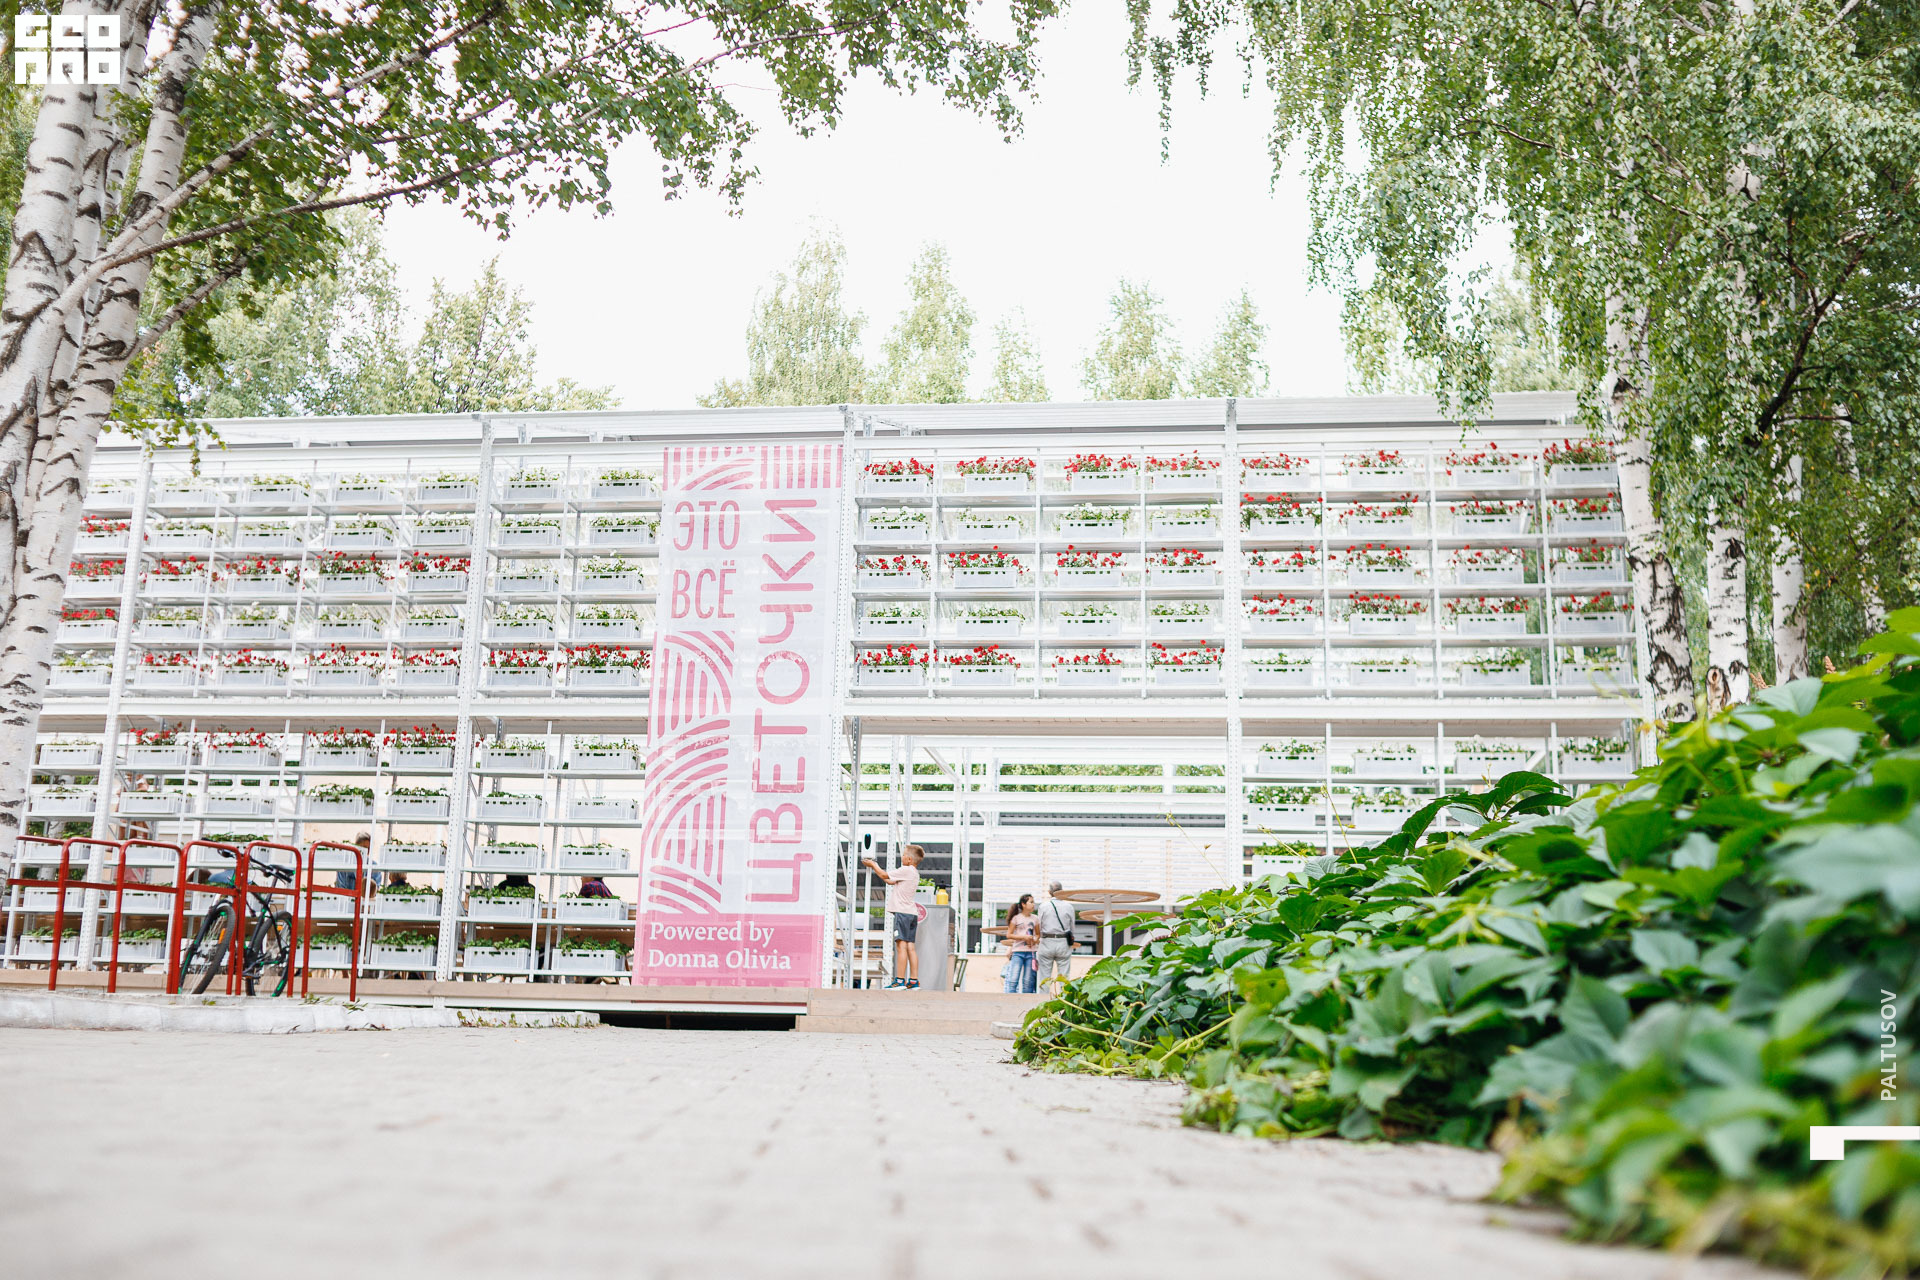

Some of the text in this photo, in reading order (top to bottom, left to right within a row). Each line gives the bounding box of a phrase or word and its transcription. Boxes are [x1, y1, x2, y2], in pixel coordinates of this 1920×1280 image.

[673, 500, 740, 550] ЭТО
[671, 560, 737, 619] ВСЁ
[745, 499, 818, 903] ЦВЕТОЧКИ
[648, 948, 792, 970] Donna Olivia
[649, 921, 775, 947] Powered by
